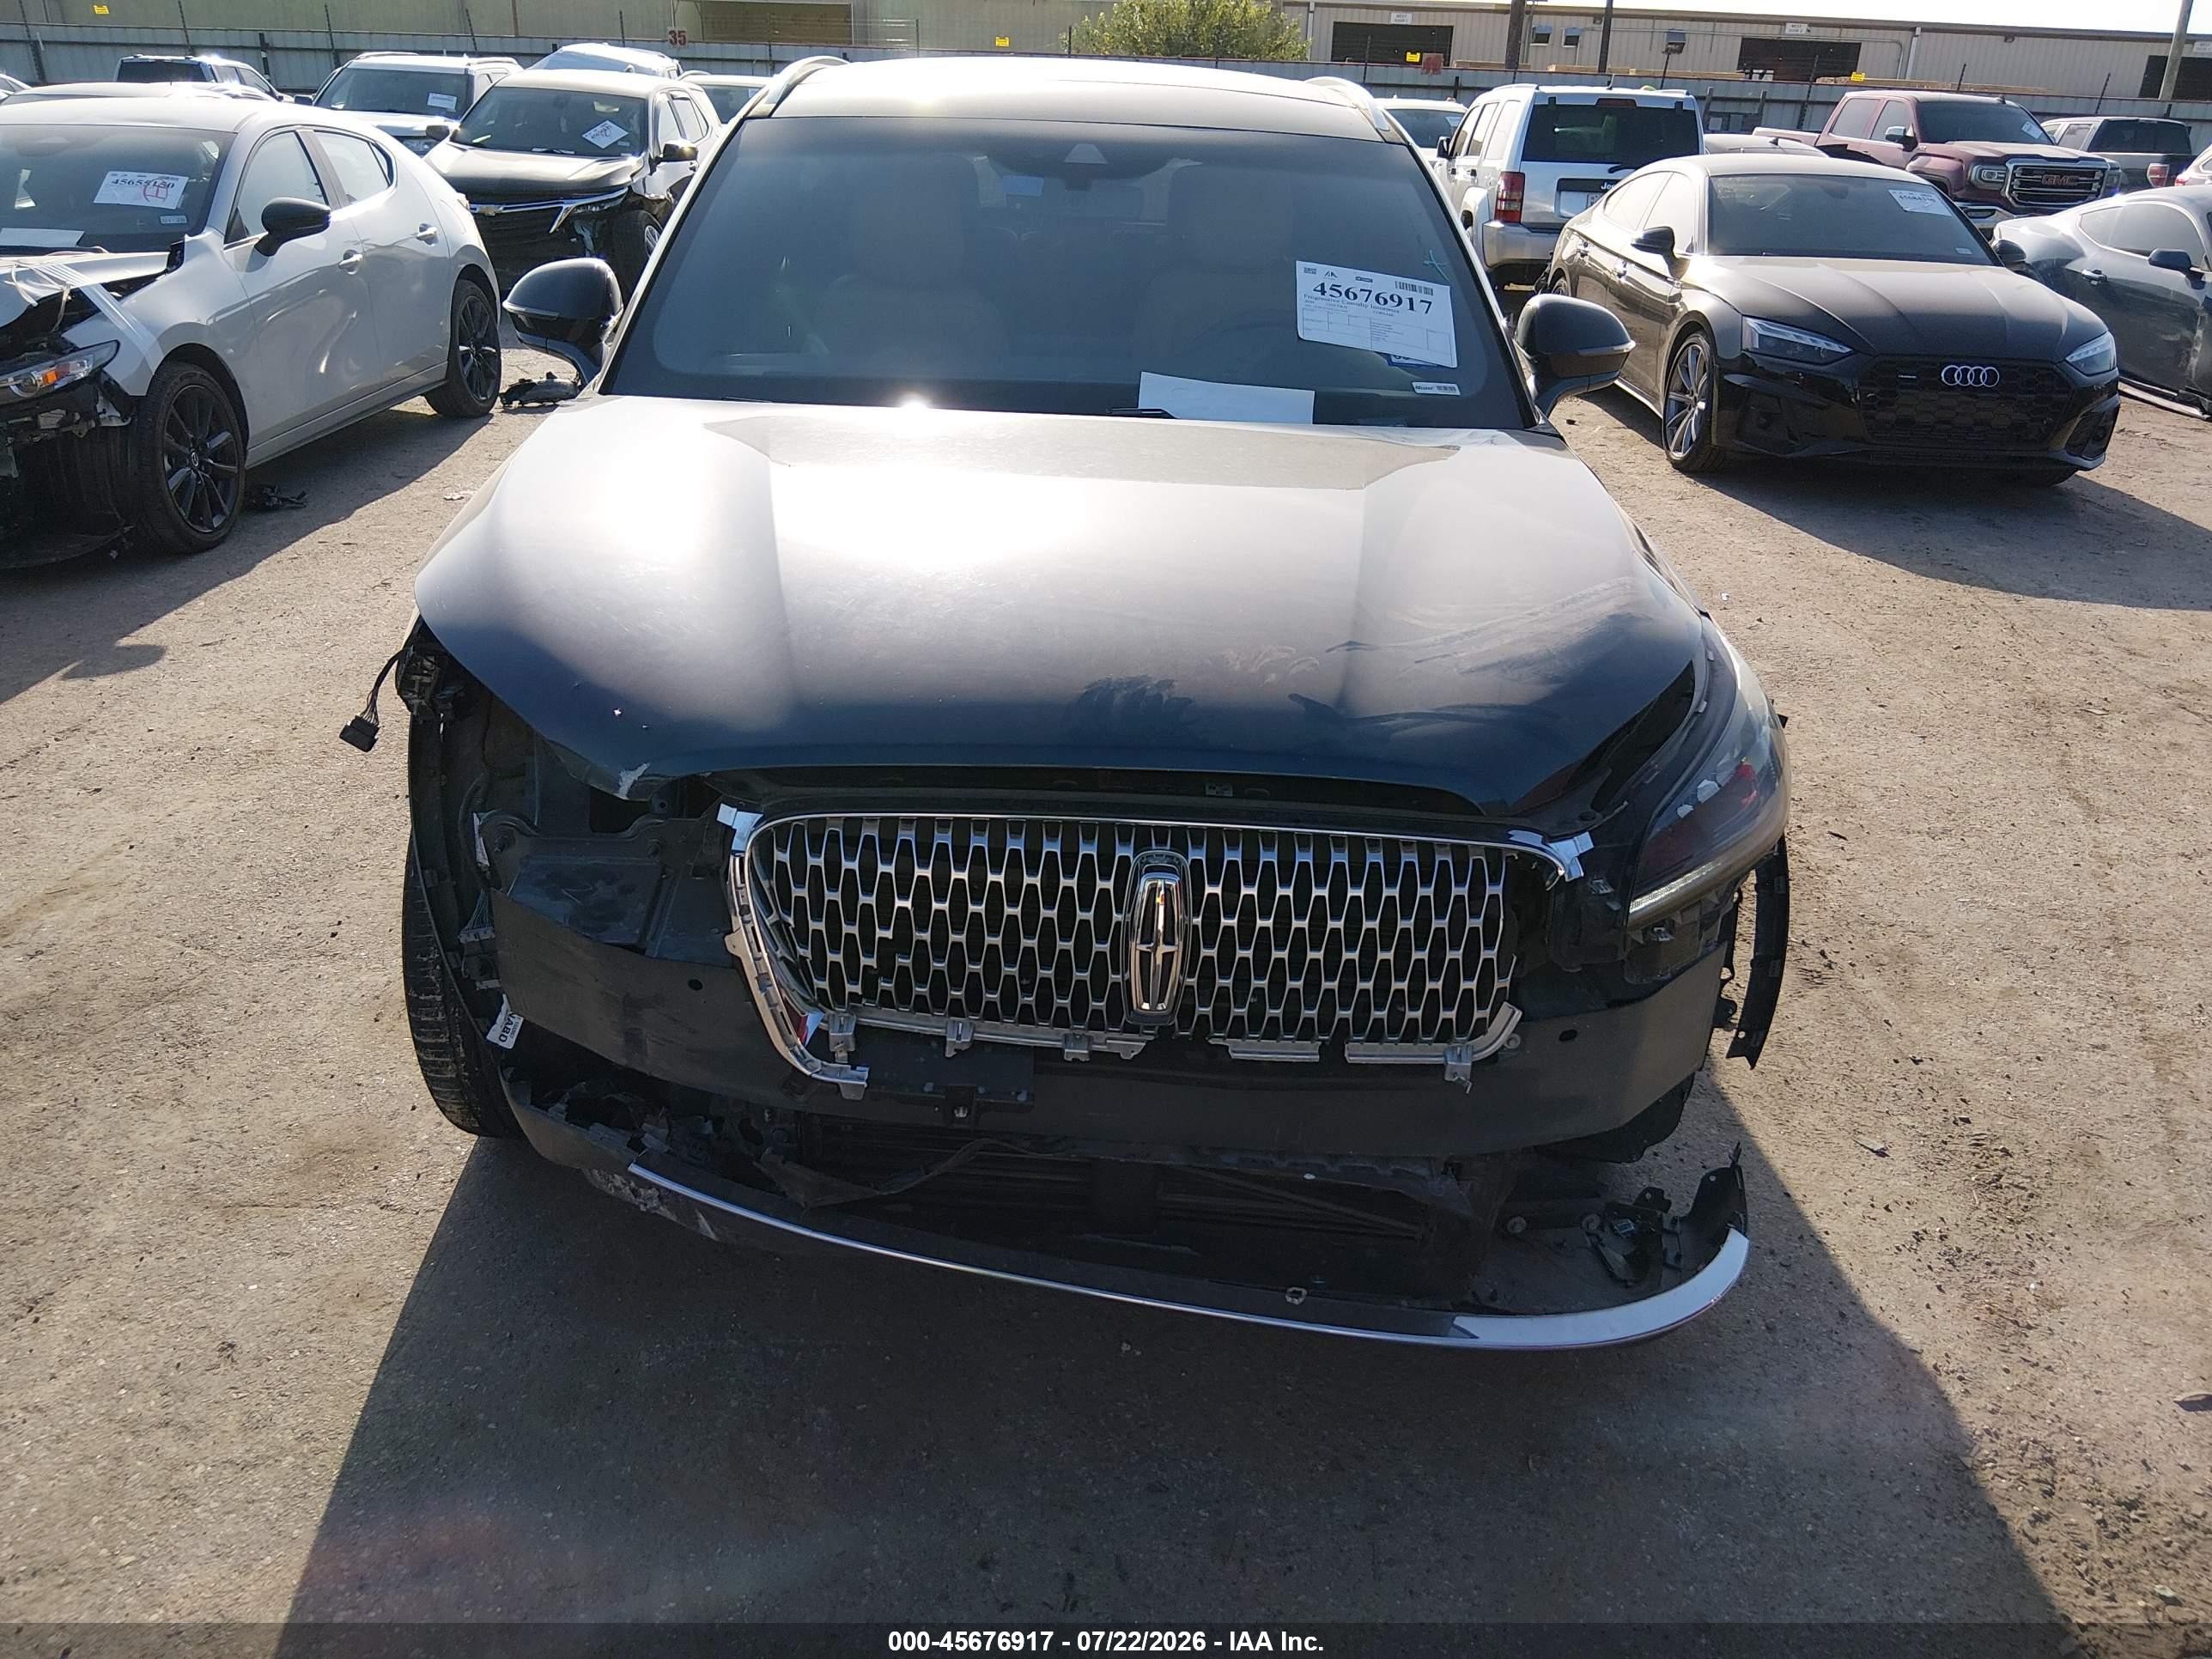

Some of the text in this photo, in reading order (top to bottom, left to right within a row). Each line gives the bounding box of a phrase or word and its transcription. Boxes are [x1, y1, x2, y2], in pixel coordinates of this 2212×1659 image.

[668, 30, 688, 46] 35
[2041, 174, 2081, 185] GMC
[1313, 282, 1433, 315] 45676917
